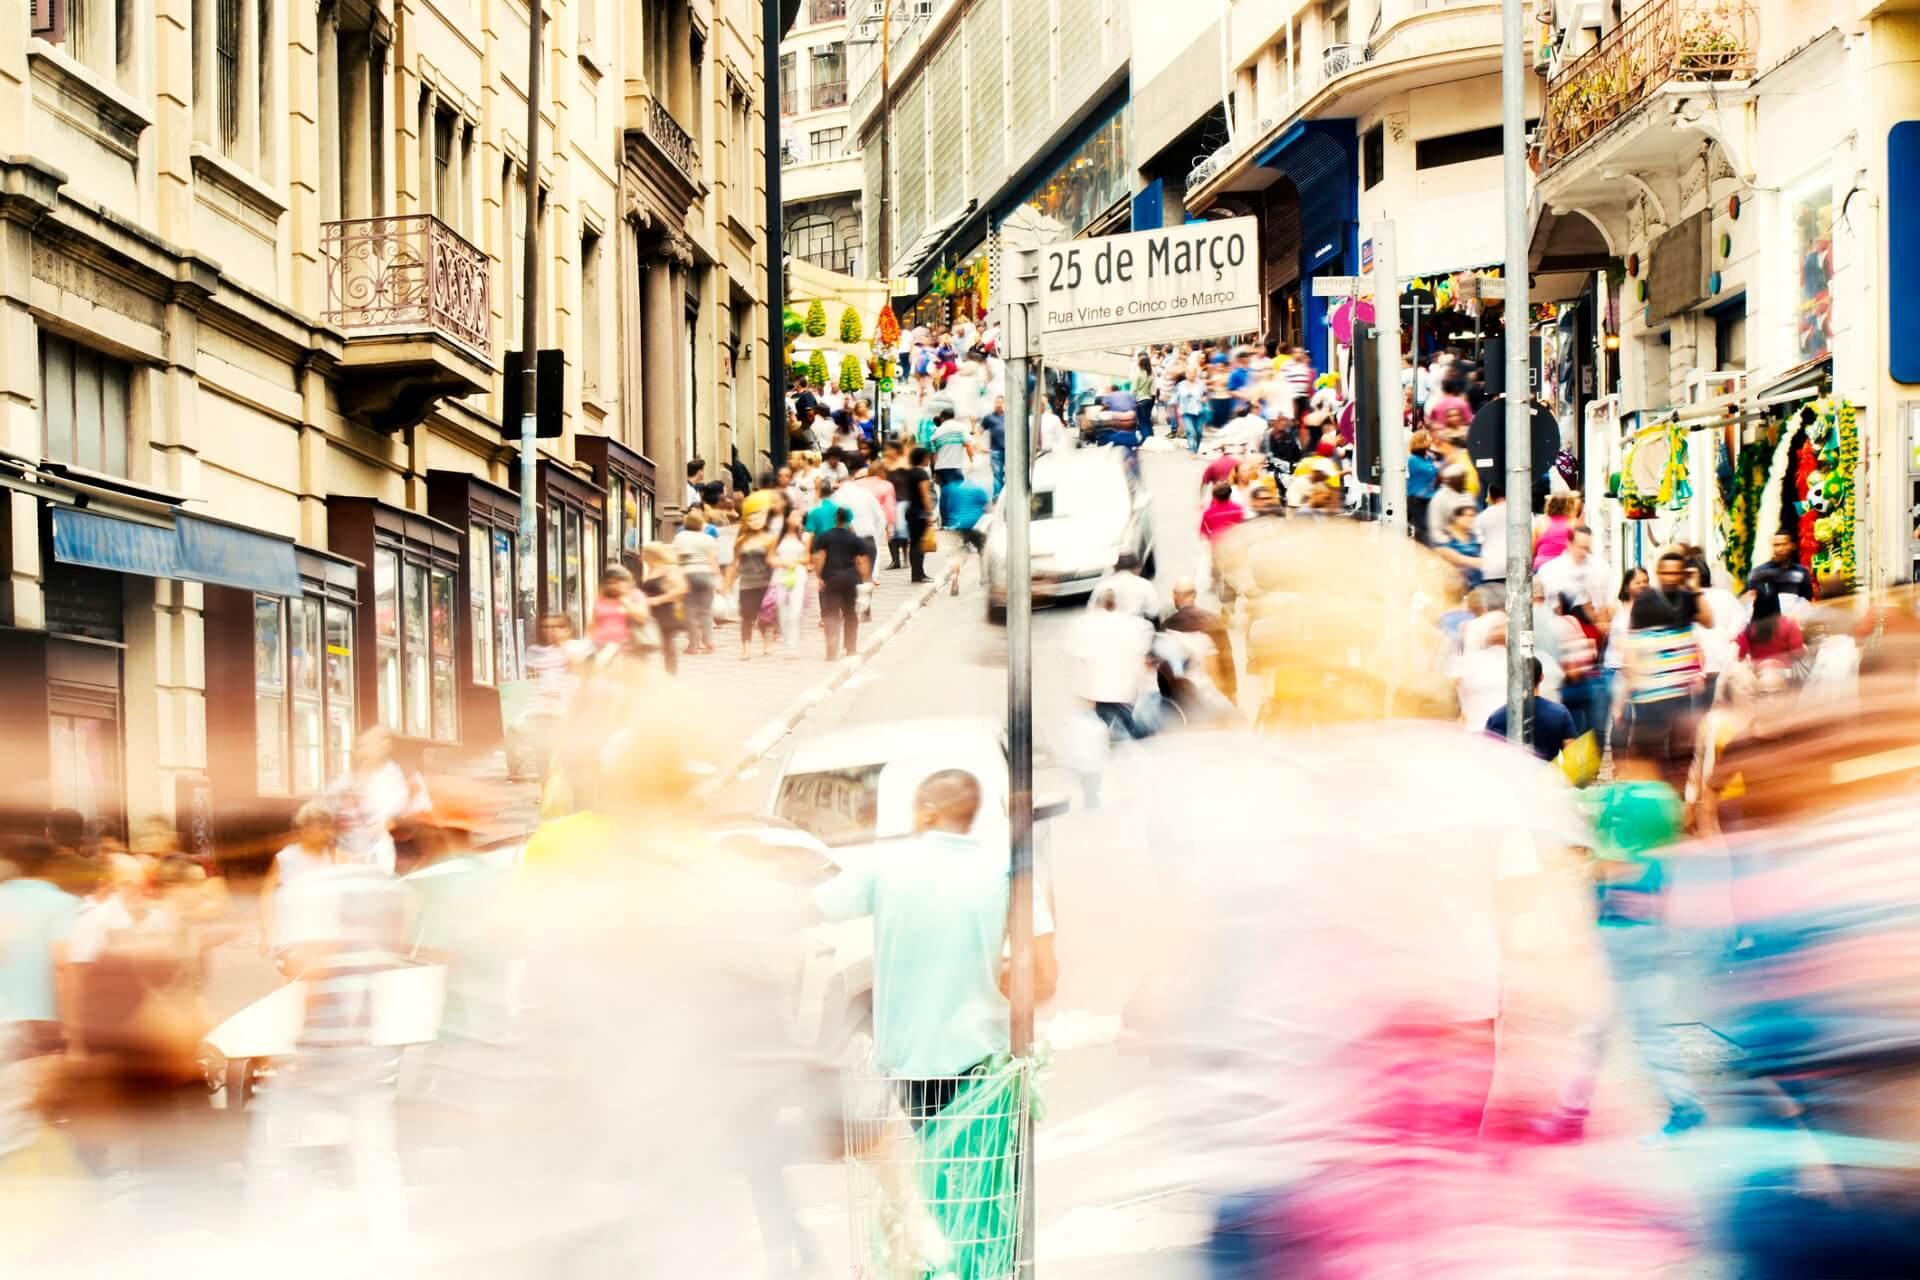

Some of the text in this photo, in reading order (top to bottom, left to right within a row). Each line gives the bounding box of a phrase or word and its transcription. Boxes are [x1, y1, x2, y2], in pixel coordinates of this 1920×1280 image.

[1048, 232, 1245, 292] 25 de Março
[1048, 290, 1235, 325] Rua Vinte e Cinco de Março
